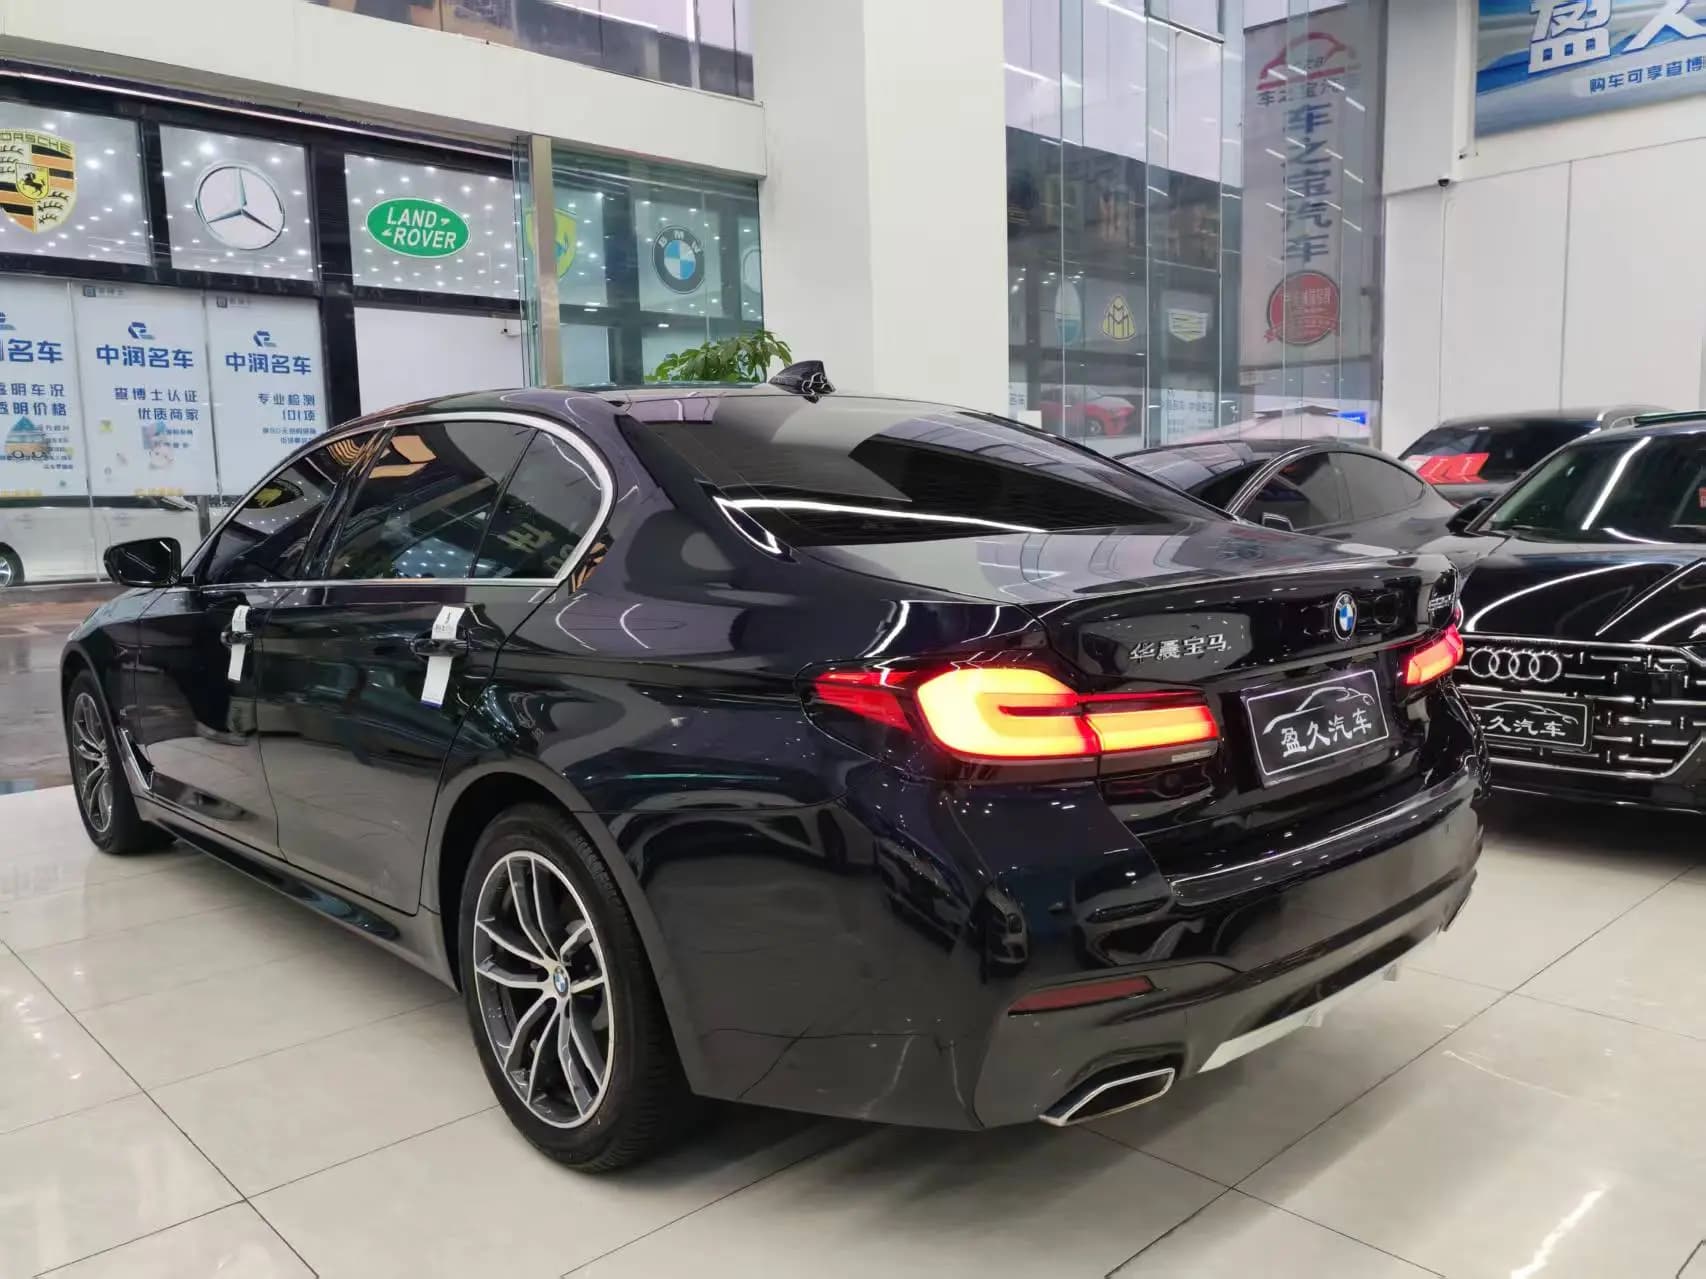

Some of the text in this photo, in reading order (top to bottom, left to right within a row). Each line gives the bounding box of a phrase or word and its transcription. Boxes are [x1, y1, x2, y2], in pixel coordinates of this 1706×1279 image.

[386, 205, 439, 230] LAND
[392, 228, 458, 250] ROVER
[658, 230, 702, 254] BMW
[96, 344, 195, 369] 中润名车
[225, 351, 312, 375] 中润名车
[113, 387, 199, 403] 查博士认证
[257, 393, 316, 406] 专业检测
[138, 407, 200, 421] 优质商家
[1129, 633, 1228, 664] 华晨宝马
[1280, 706, 1373, 758] 盈久汽车
[1476, 713, 1567, 737] 久汽车
